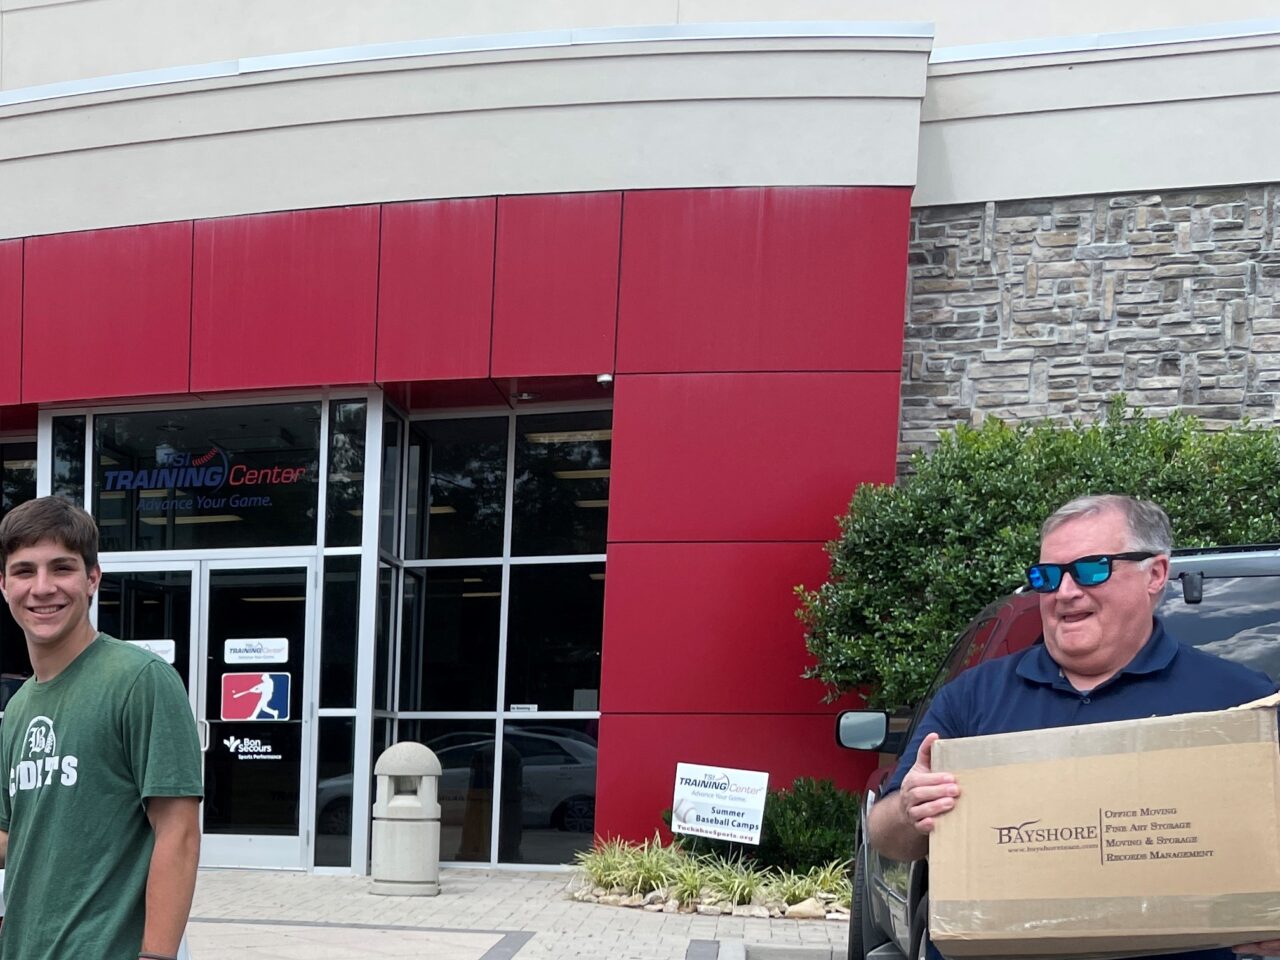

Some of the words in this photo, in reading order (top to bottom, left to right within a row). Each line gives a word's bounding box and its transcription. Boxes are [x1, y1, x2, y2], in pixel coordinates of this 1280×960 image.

[164, 452, 191, 467] TSI
[104, 466, 223, 490] TRAINING
[229, 465, 306, 486] Center
[136, 498, 193, 512] Advance
[197, 496, 225, 509] Your
[238, 743, 272, 753] Secours
[243, 738, 261, 747] Bon
[680, 777, 728, 791] TRAINING
[711, 806, 746, 818] Summer
[696, 815, 730, 826] Baseball
[731, 820, 759, 831] Camps
[996, 826, 1098, 845] BAYSHORE
[1145, 837, 1154, 845] &
